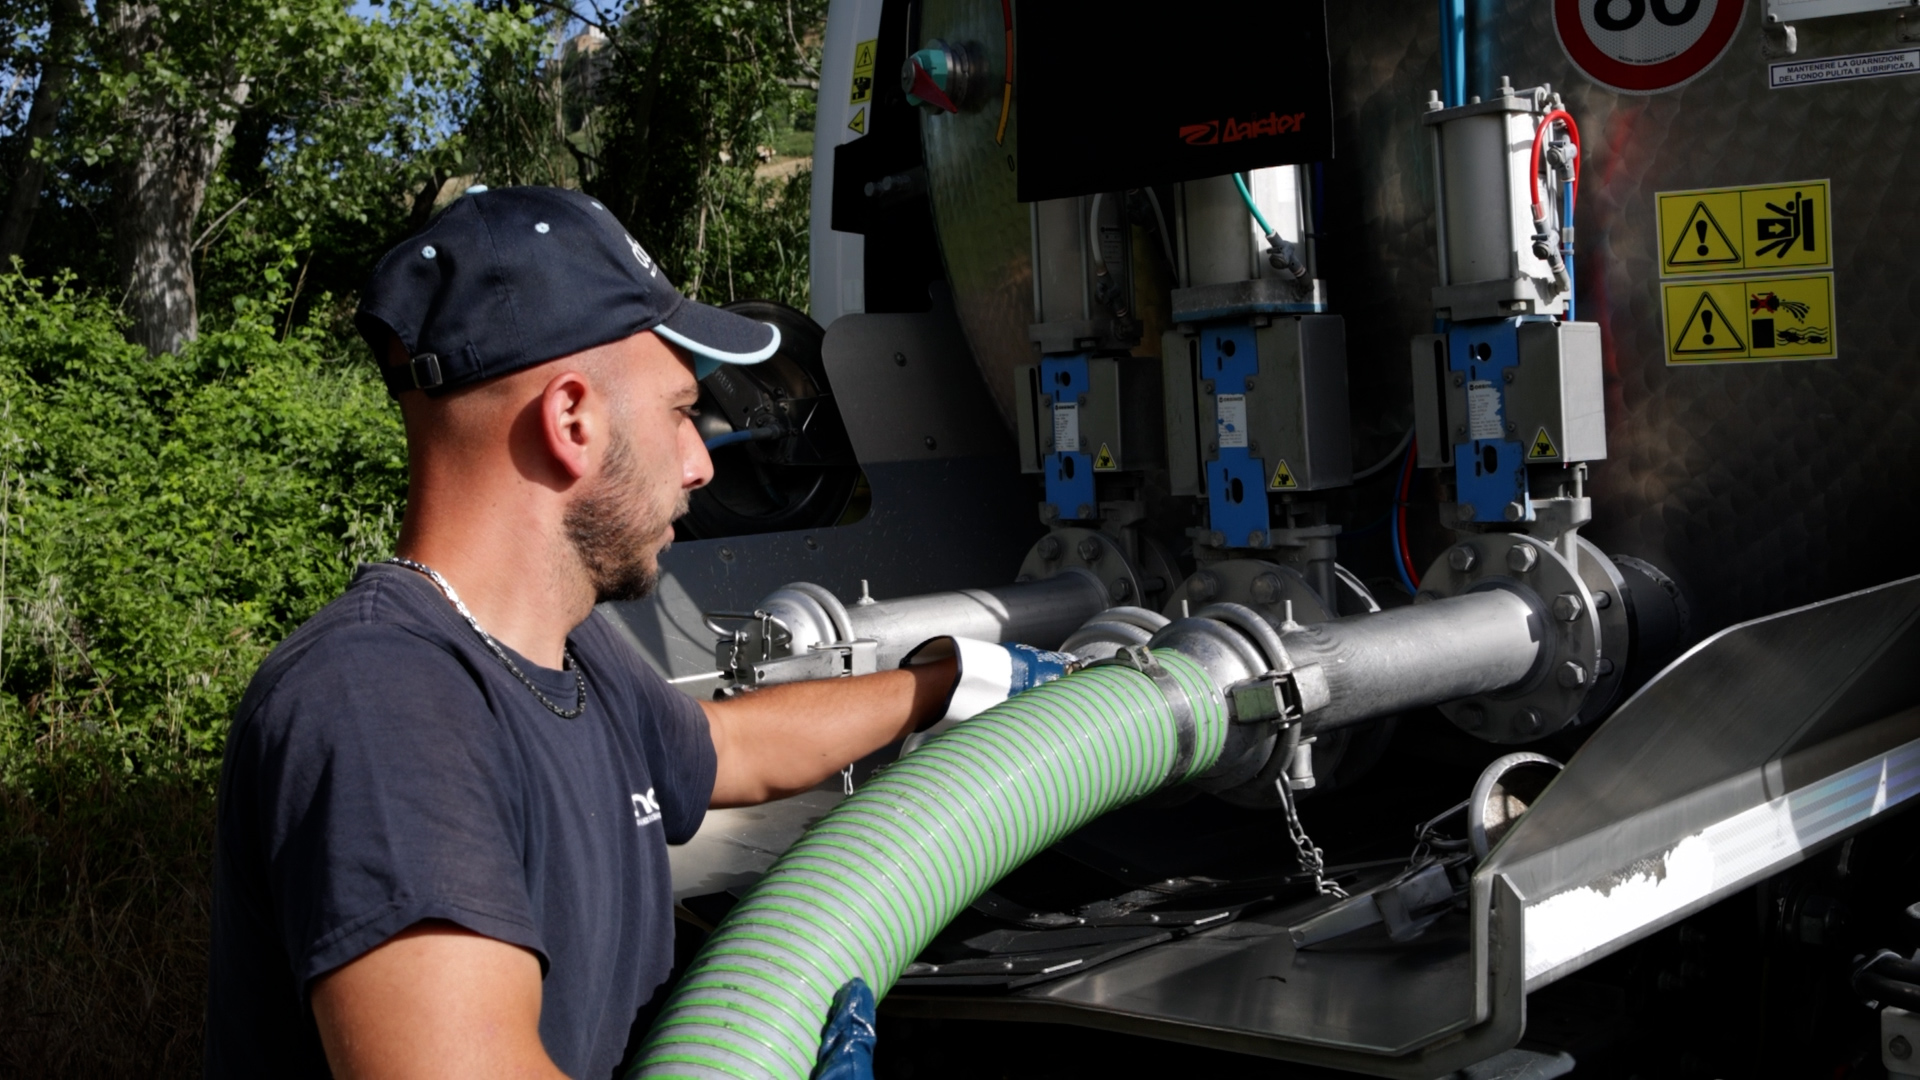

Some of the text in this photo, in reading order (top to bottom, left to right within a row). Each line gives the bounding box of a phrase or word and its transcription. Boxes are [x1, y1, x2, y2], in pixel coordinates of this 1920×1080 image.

[1779, 74, 1794, 83] DEL
[1796, 71, 1824, 81] FONDO
[1825, 69, 1853, 78] PULITA
[1862, 62, 1914, 74] LUBRIFICATA
[1787, 55, 1905, 74] MANTENERE LA GUARNIZIONE
